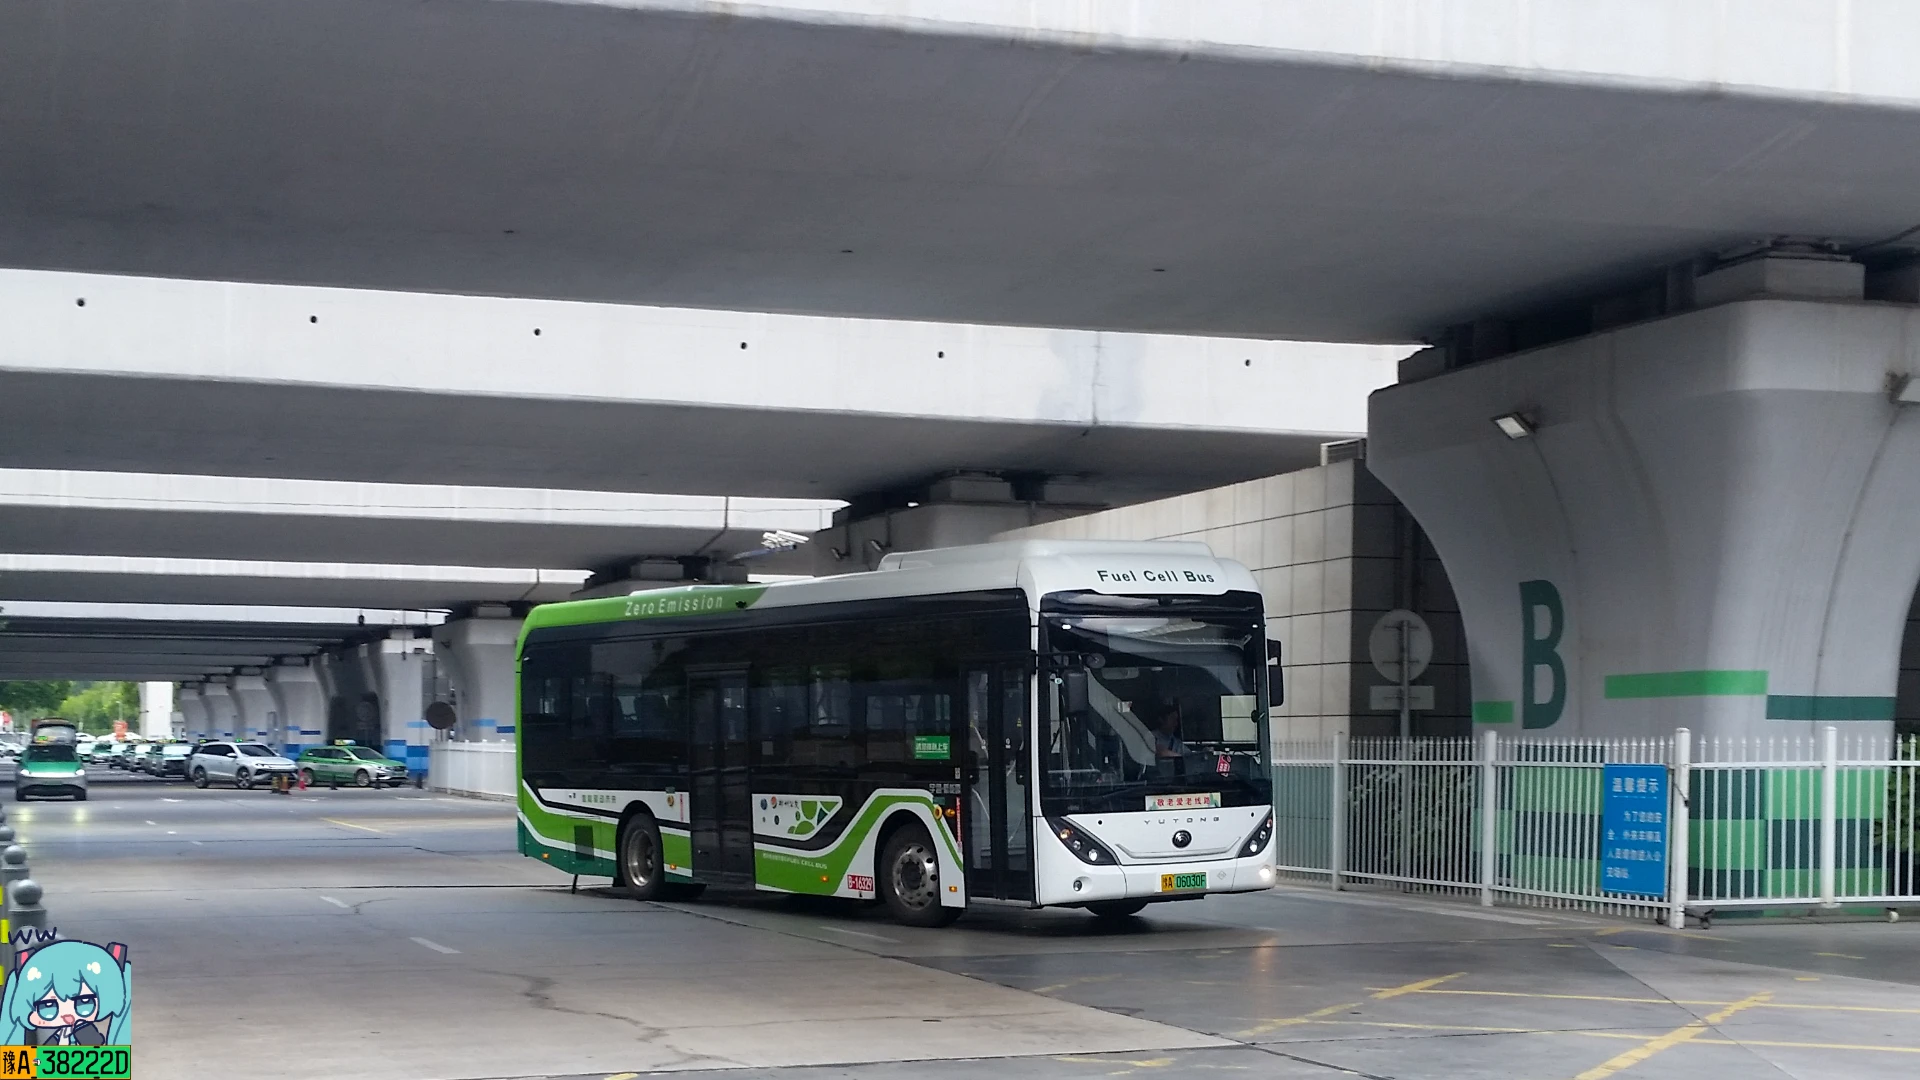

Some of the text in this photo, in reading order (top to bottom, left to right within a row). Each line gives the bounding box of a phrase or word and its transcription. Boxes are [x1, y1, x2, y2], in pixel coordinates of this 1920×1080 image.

[1096, 570, 1215, 583] Fuel Cell Bus
[625, 595, 723, 616] Zero Emission
[1519, 580, 1567, 730] B
[1612, 777, 1659, 793] 温馨提示
[1144, 816, 1219, 825] YUTONG
[848, 876, 873, 891] B-16329
